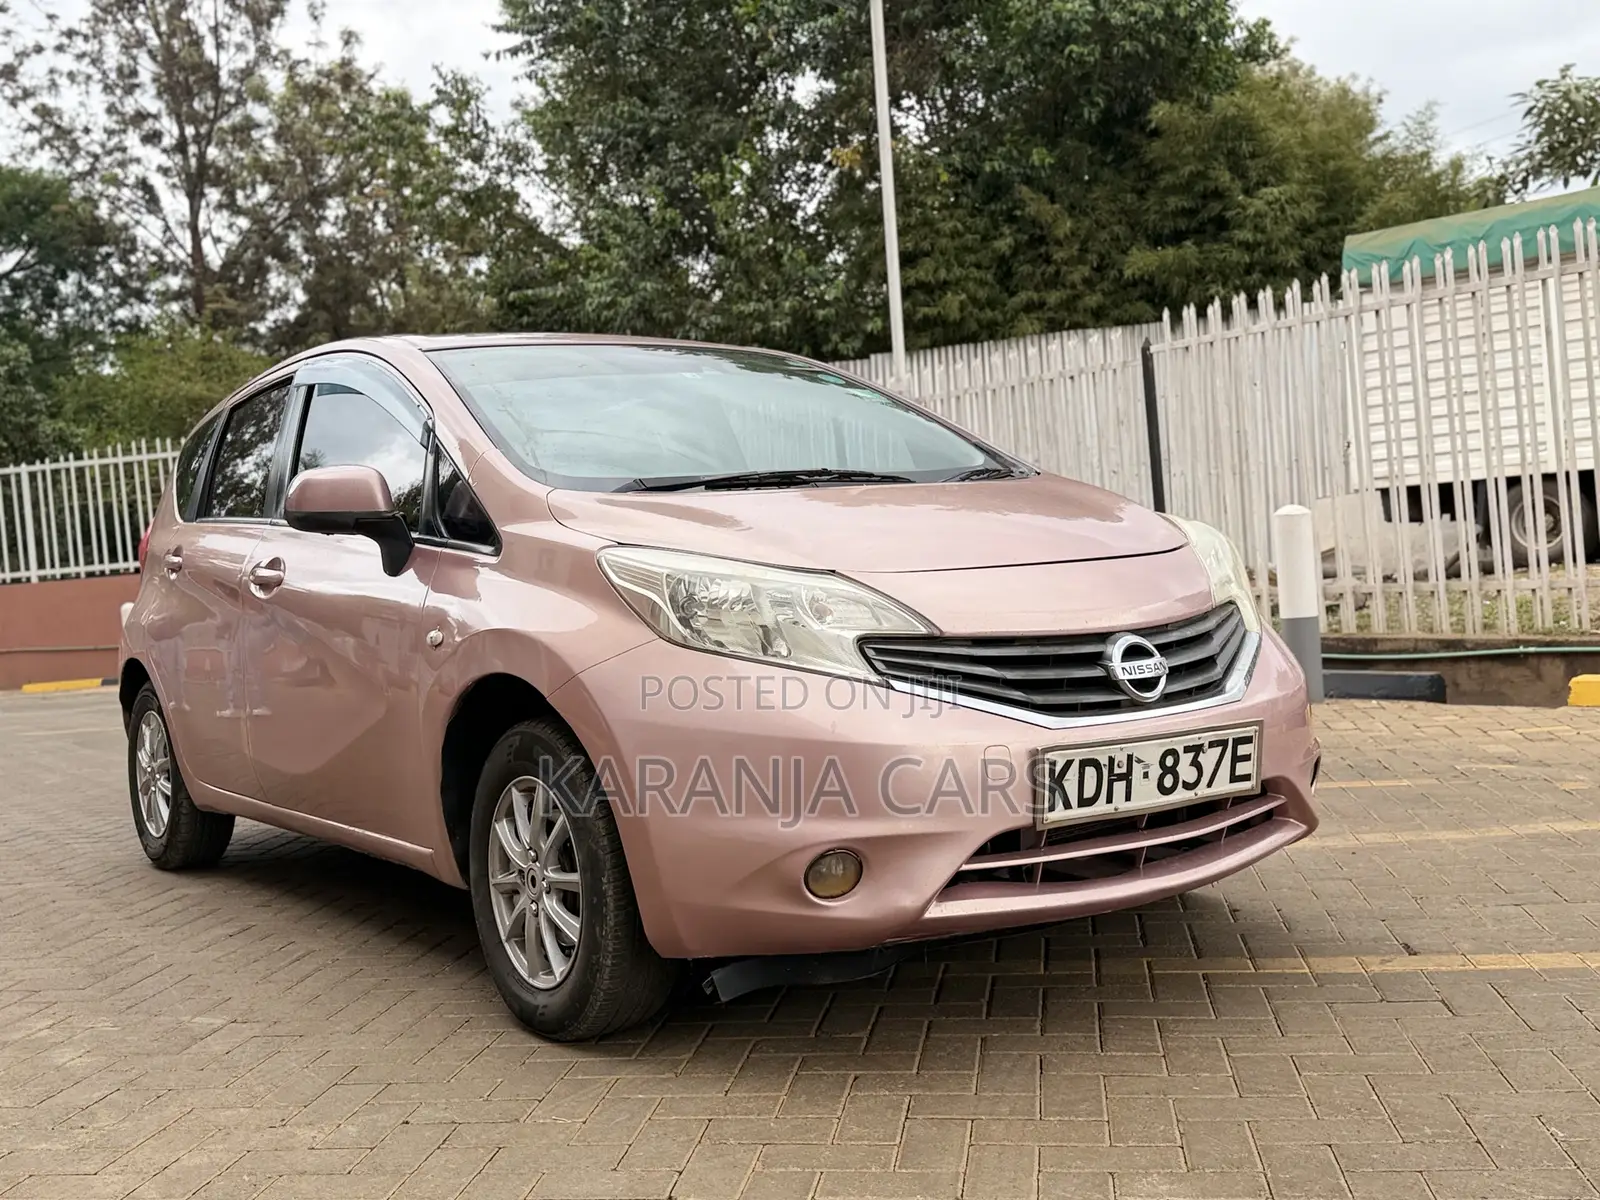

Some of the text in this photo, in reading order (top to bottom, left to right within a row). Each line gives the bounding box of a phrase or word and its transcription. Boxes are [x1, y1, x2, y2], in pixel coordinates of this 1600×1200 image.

[1121, 661, 1167, 676] NISSAN
[1048, 735, 1254, 812] KDH 837E
